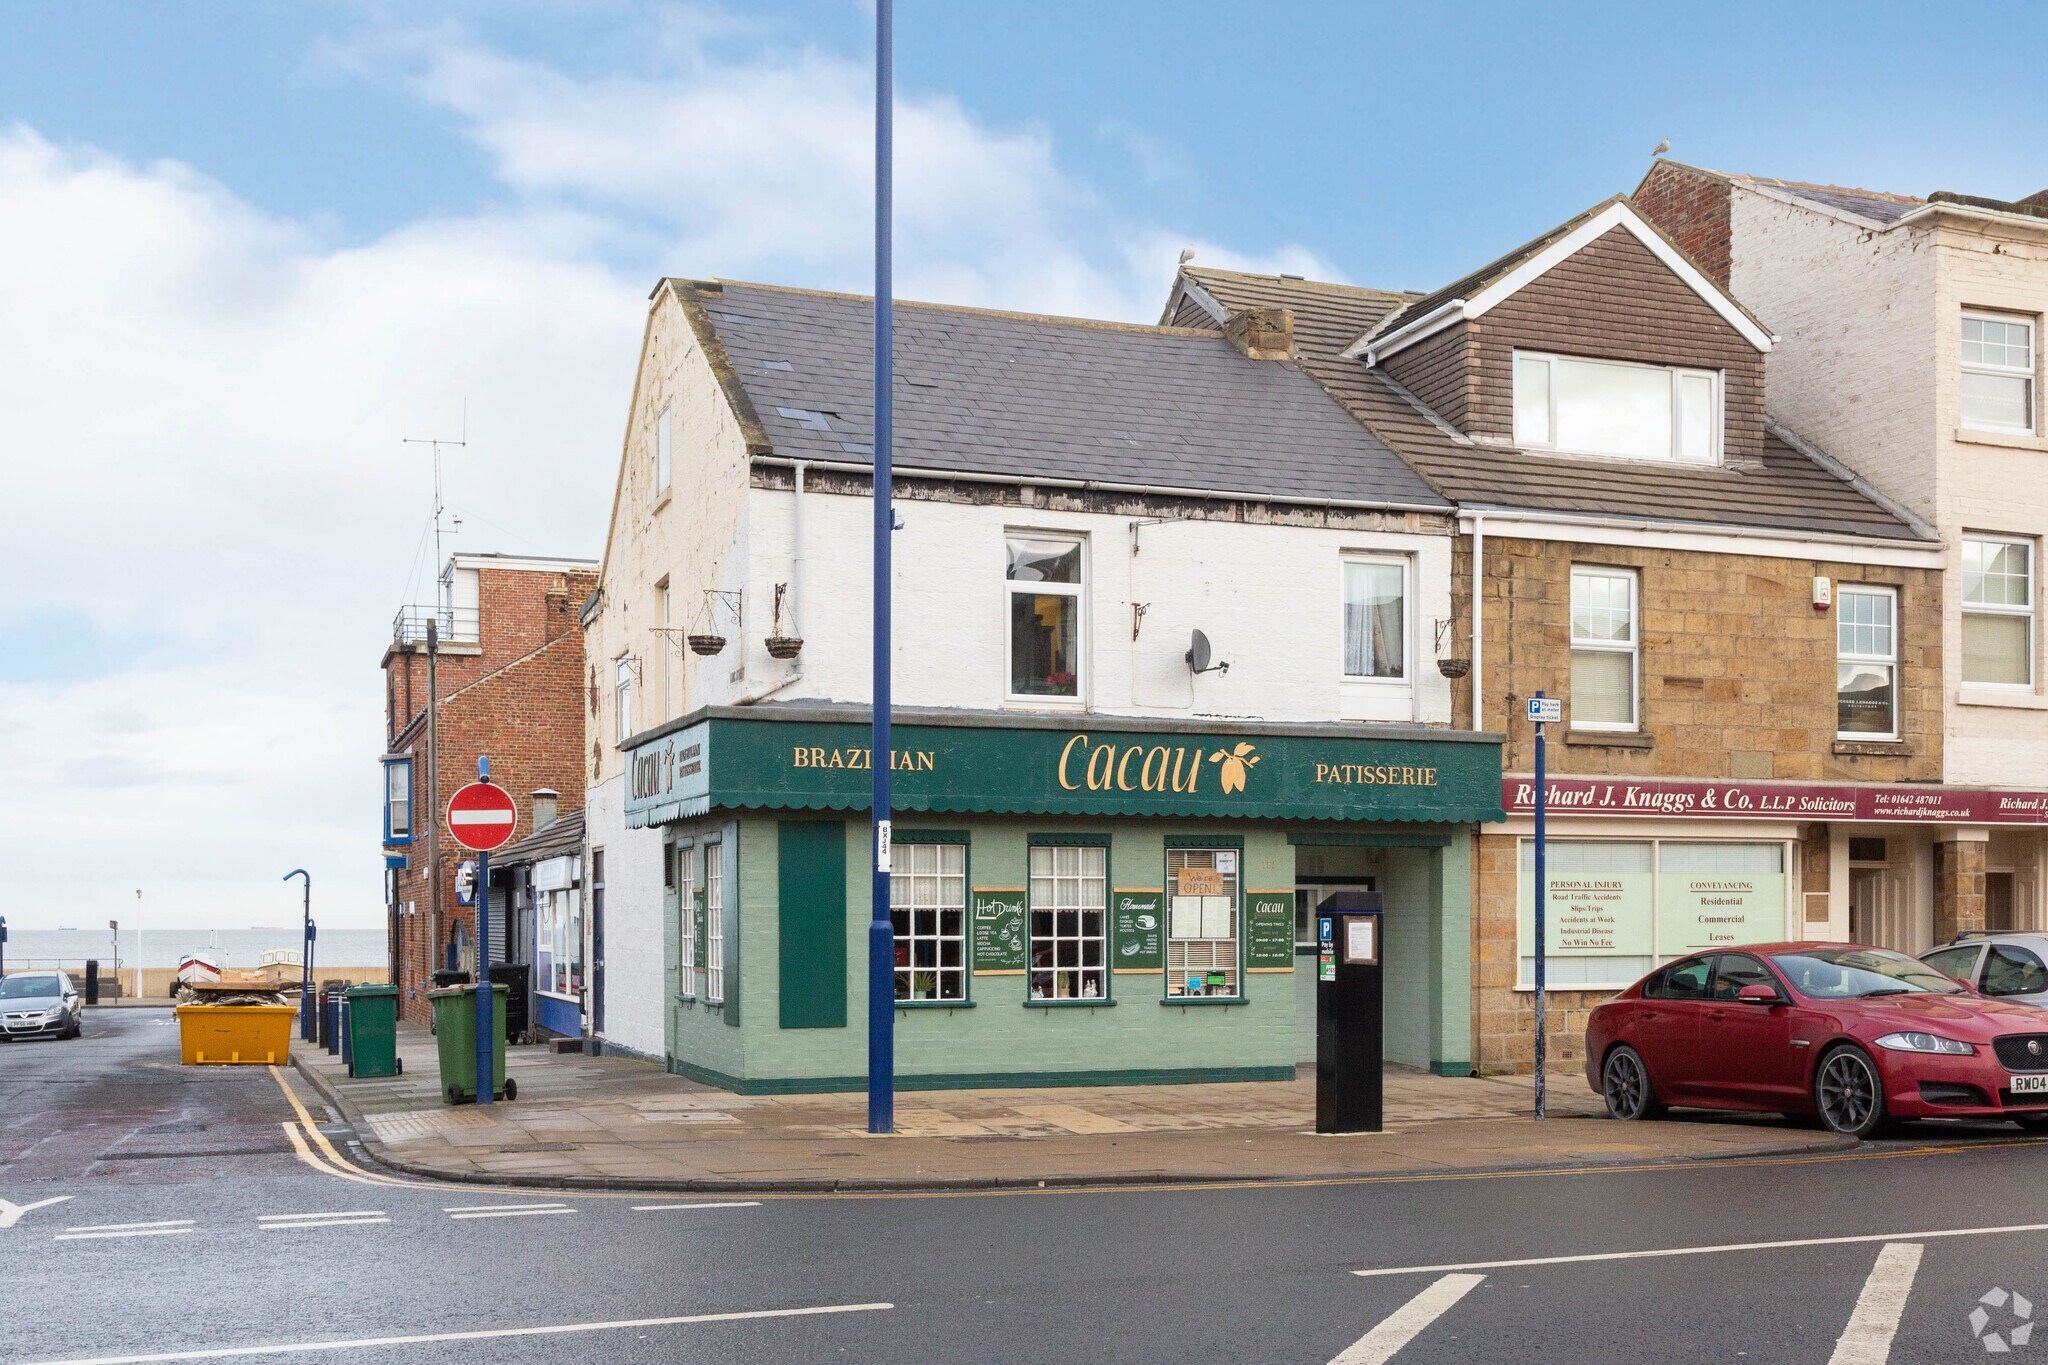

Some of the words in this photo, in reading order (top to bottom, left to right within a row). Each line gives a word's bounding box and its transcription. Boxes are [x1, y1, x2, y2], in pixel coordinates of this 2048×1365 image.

[793, 747, 935, 770] BRAZIIAN
[1058, 734, 1202, 793] Cacau
[1315, 764, 1438, 786] PATISSERIE
[1600, 785, 1616, 806] J.
[1622, 786, 1695, 813] Knaggs
[1700, 788, 1716, 808] &
[1724, 788, 1753, 809] Co.
[1760, 795, 1795, 810] L.L.P
[1799, 796, 1855, 812] Solicitors
[1875, 794, 1890, 804] Tel:
[1891, 795, 1914, 804] 01642
[1915, 796, 1942, 805] 487011
[2000, 797, 2038, 809] Richard
[1874, 807, 1970, 818] www.richardjknaggs.co.uk
[1256, 900, 1284, 913] Cacau
[1700, 897, 1742, 906] Residential
[1698, 915, 1744, 923] Commercial
[1709, 932, 1734, 941] Leases
